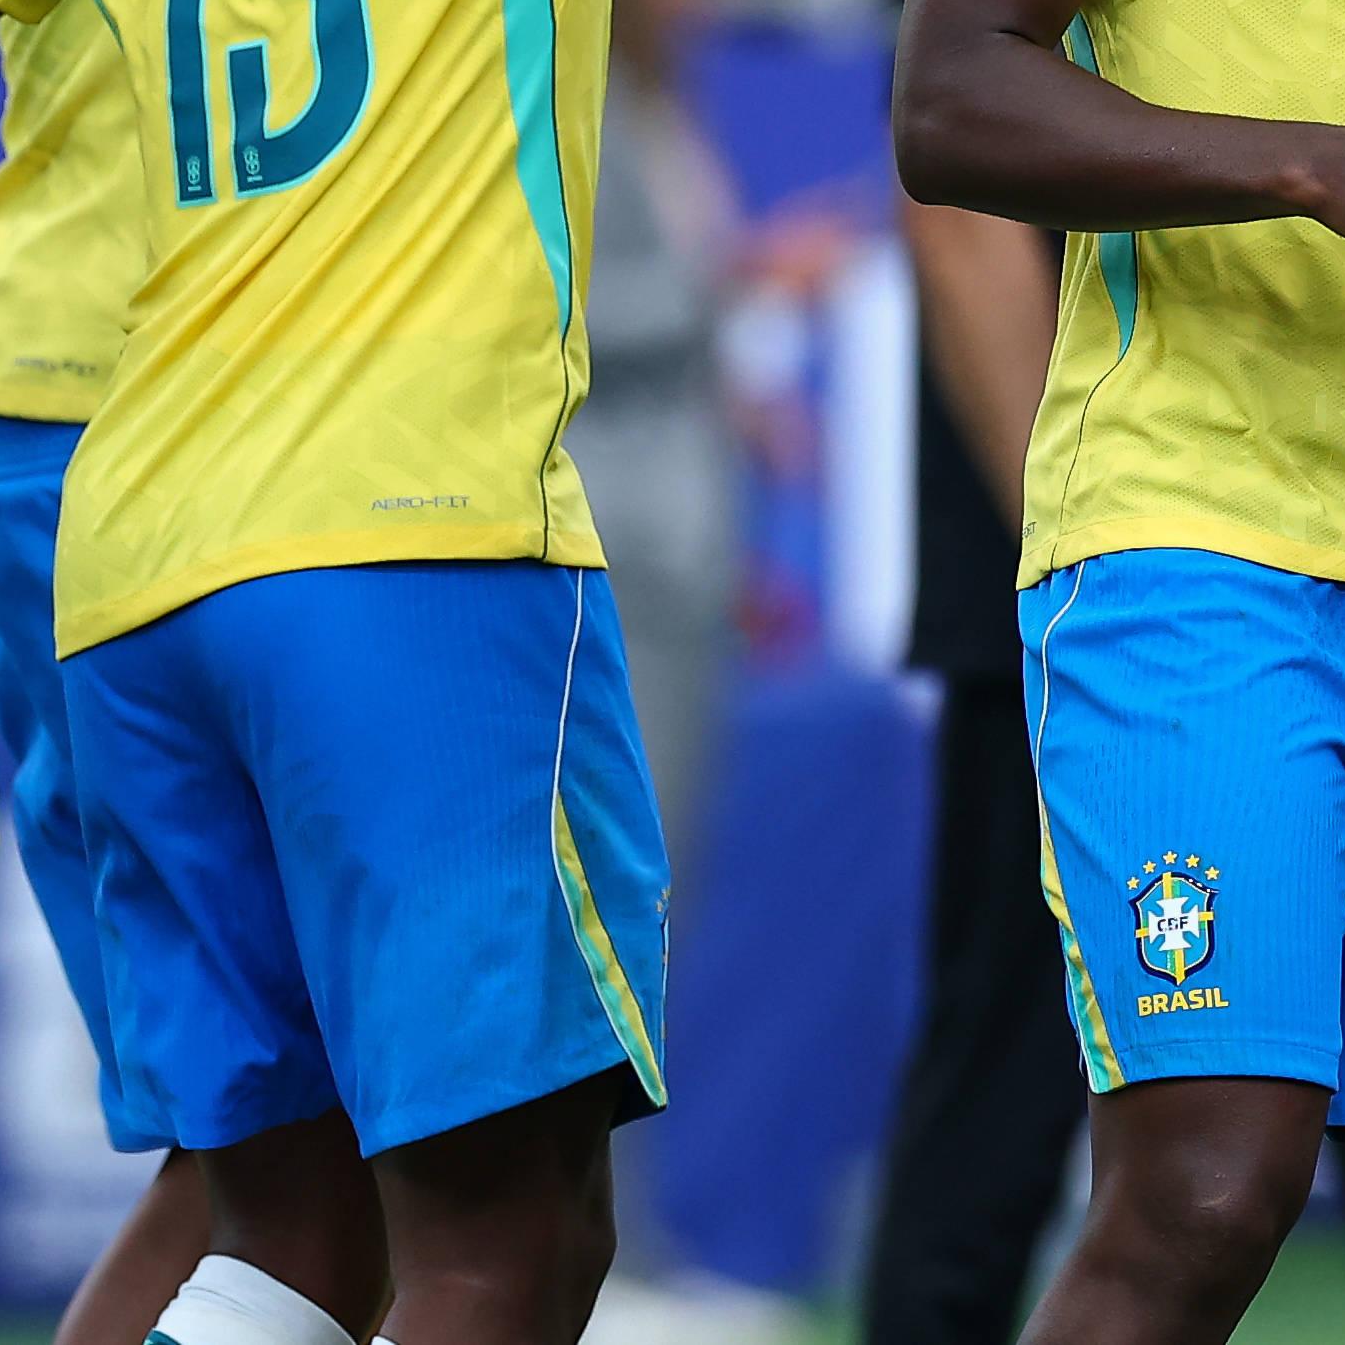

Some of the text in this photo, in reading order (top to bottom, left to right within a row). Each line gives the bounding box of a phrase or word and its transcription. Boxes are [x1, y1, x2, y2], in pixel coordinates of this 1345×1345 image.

[371, 495, 470, 511] AERO-FIT
[1156, 915, 1190, 932] CBF
[1137, 986, 1230, 1017] BRASIL
